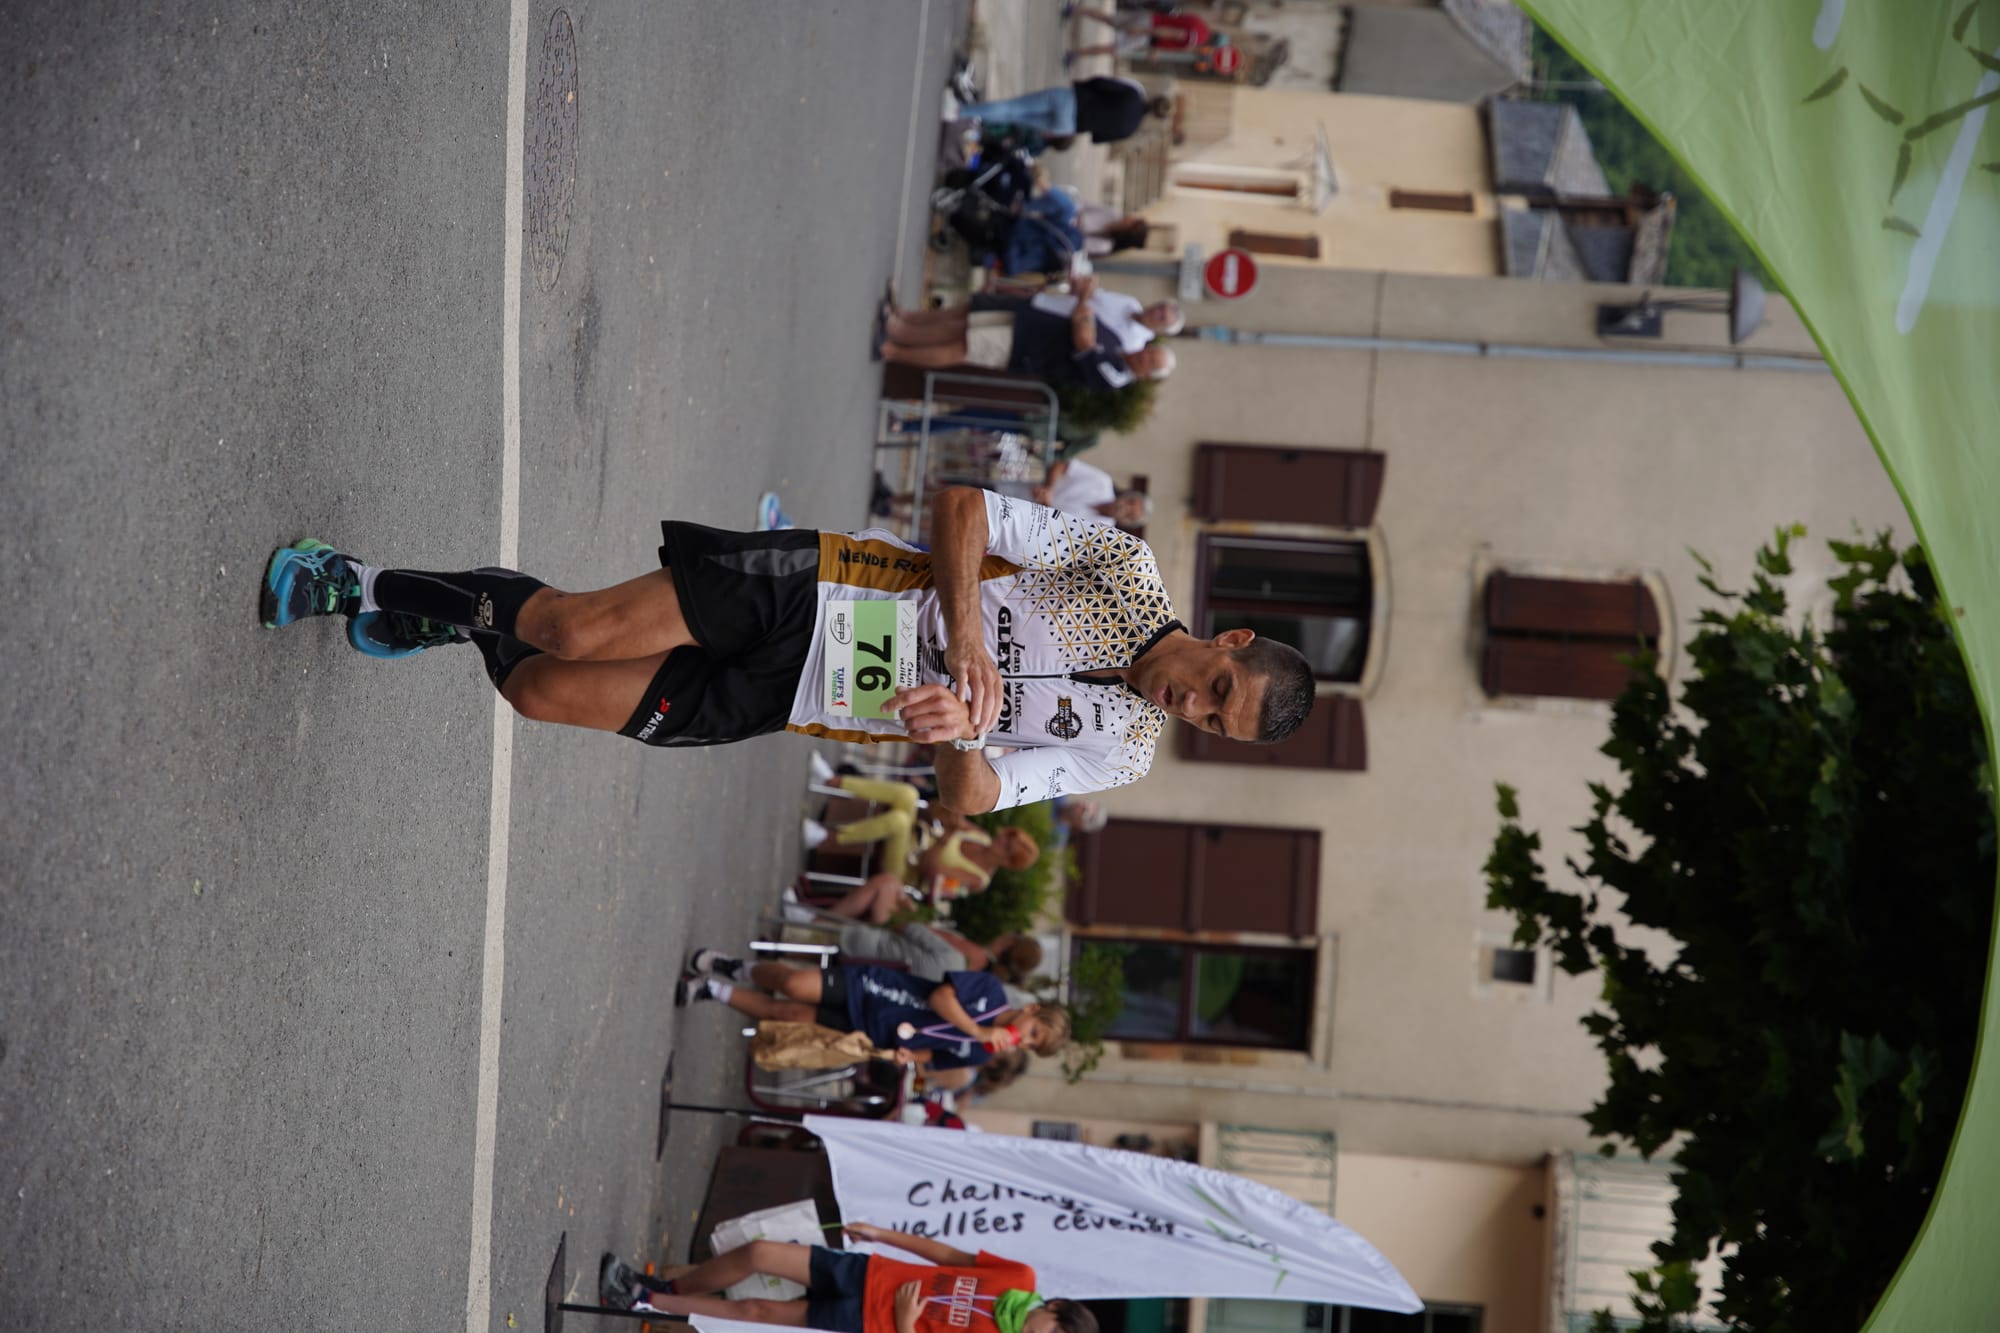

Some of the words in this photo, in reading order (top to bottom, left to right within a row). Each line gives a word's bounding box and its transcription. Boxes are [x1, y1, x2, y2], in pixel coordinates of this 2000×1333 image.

[837, 613, 845, 640] BFP
[855, 635, 892, 692] 76
[1011, 637, 1025, 673] Jean
[836, 667, 845, 698] TUFF'S
[906, 662, 914, 688] Challe
[1014, 682, 1024, 718] Marc
[1092, 703, 1104, 732] poli
